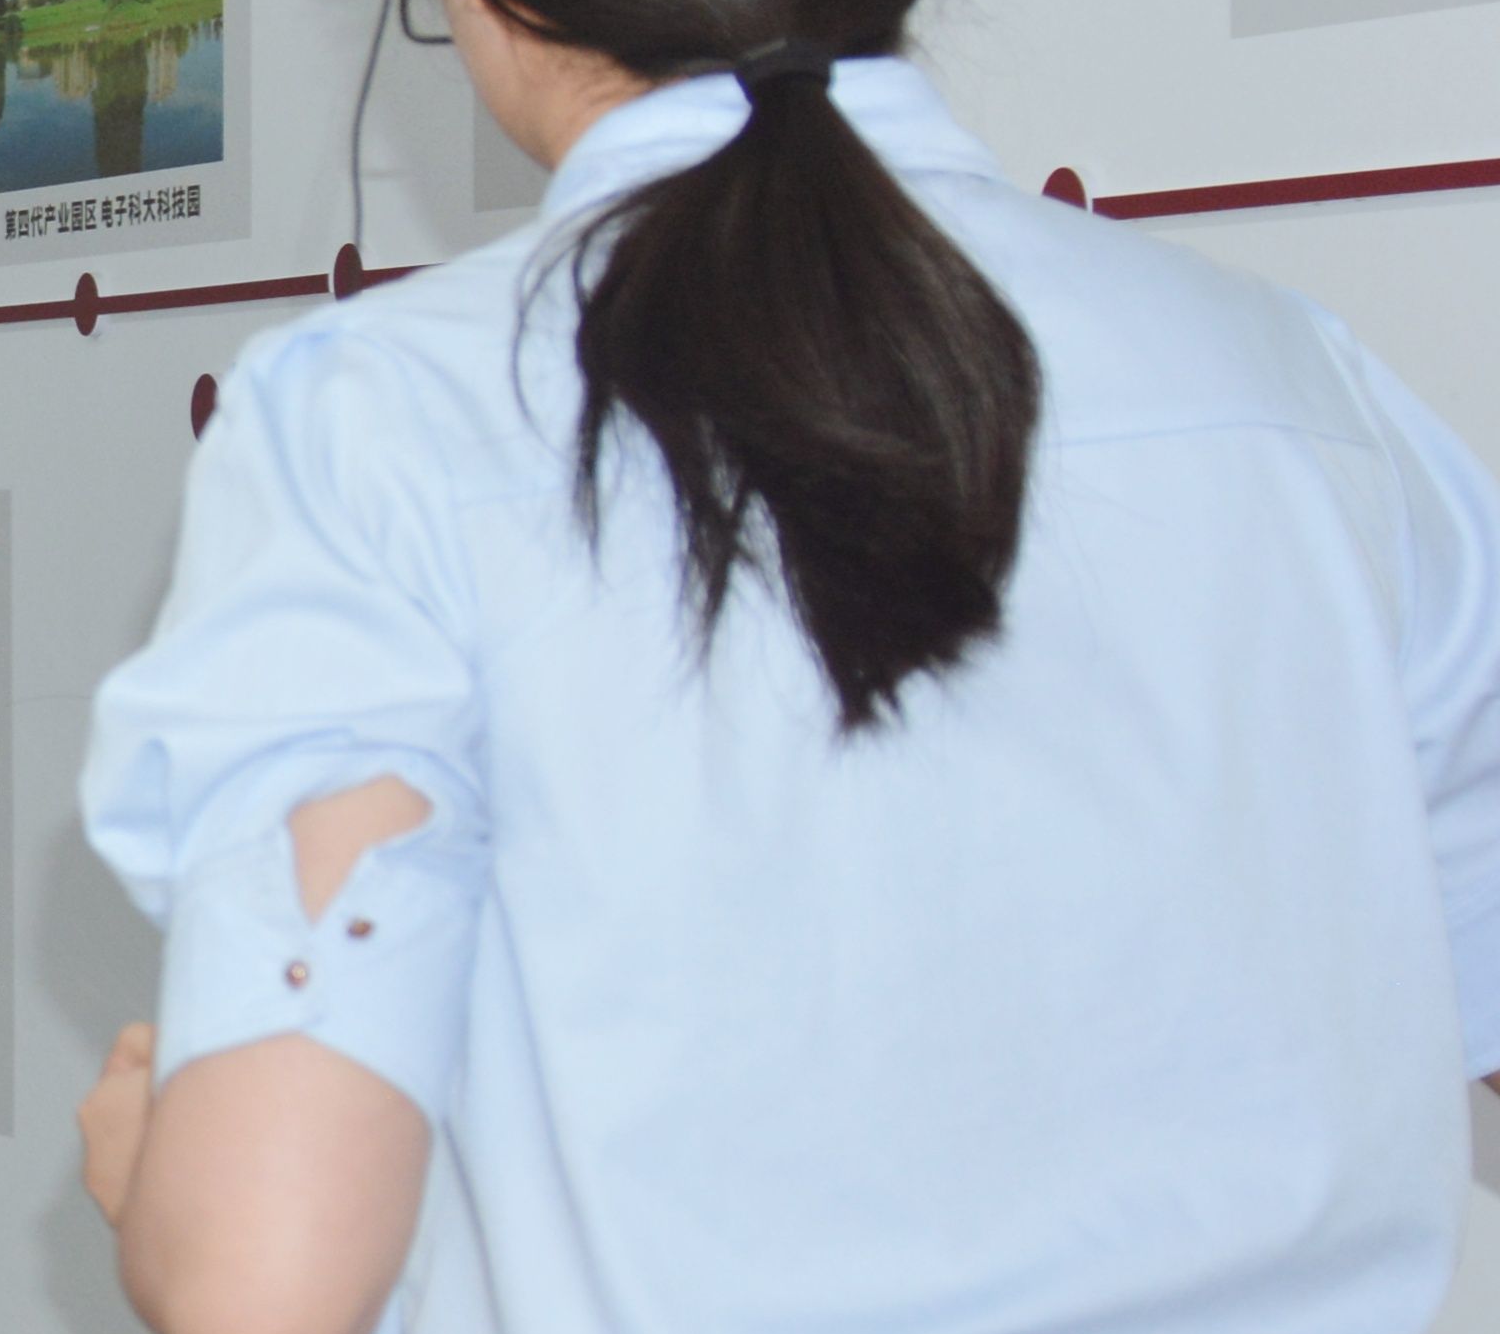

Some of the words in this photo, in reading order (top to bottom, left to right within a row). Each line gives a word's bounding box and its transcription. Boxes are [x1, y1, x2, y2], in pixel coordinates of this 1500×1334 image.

[5, 199, 97, 240] 第四代产业园区
[101, 184, 201, 229] 电子科大科技园
